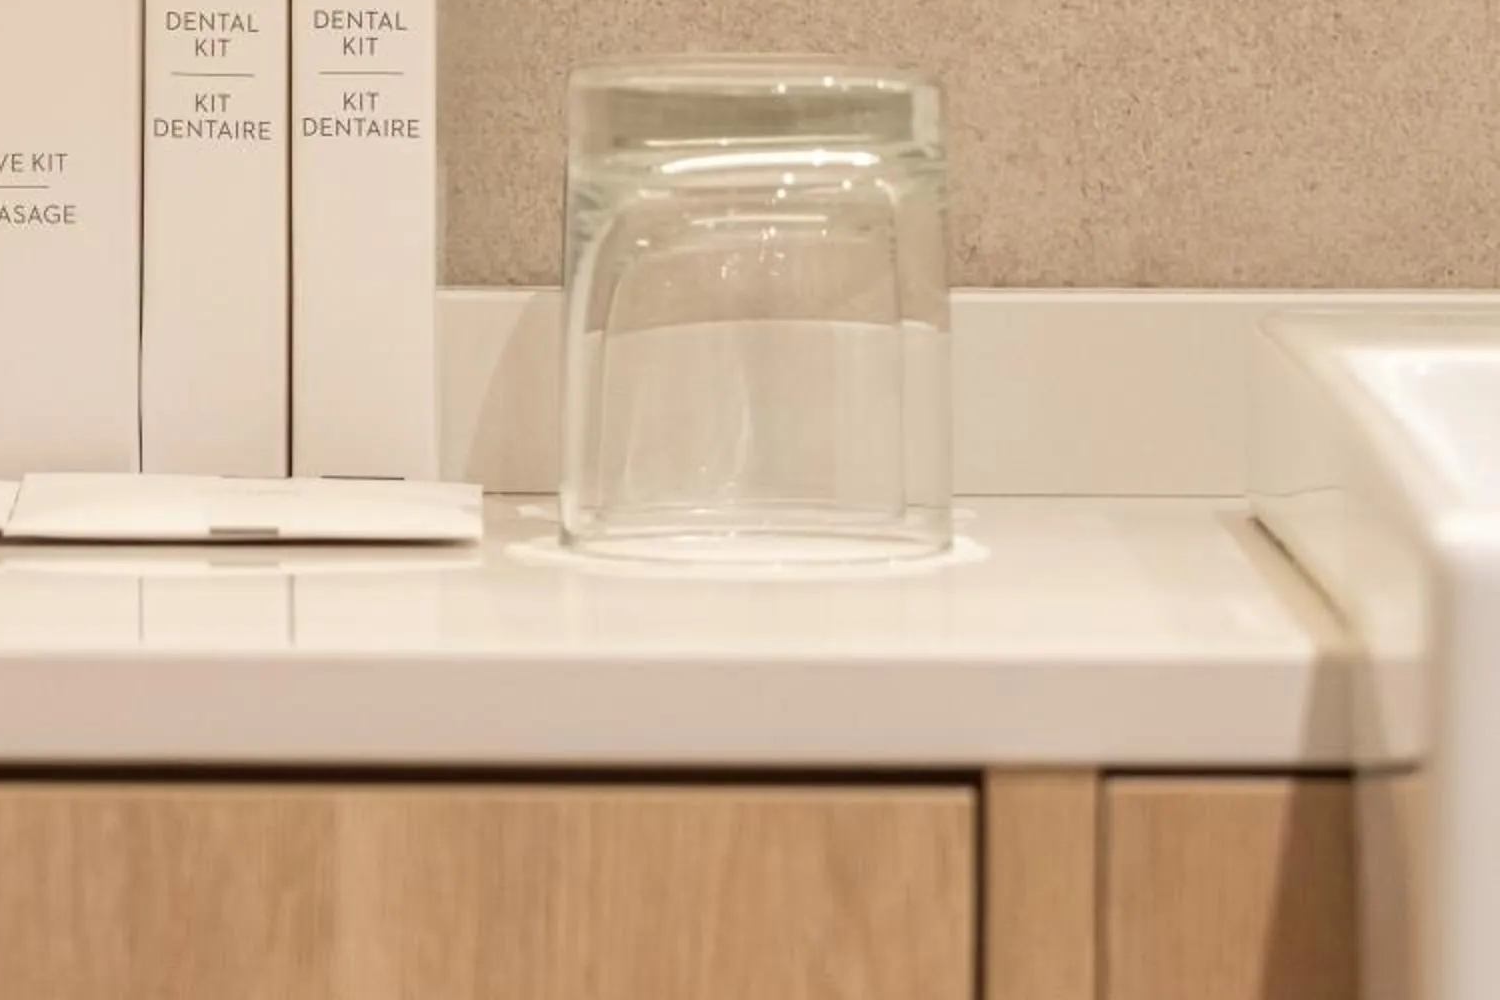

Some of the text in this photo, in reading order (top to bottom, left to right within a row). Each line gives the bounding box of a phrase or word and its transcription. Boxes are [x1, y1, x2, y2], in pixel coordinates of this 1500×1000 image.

[165, 11, 260, 33] DENTAL
[313, 9, 408, 30] DENTAL
[194, 37, 231, 58] KIT
[342, 36, 379, 57] KIT
[194, 93, 231, 113] KIT
[342, 91, 379, 112] KIT
[153, 118, 272, 141] DENTAIRE
[301, 117, 420, 139] DENTAIRE
[31, 152, 69, 173] KIT
